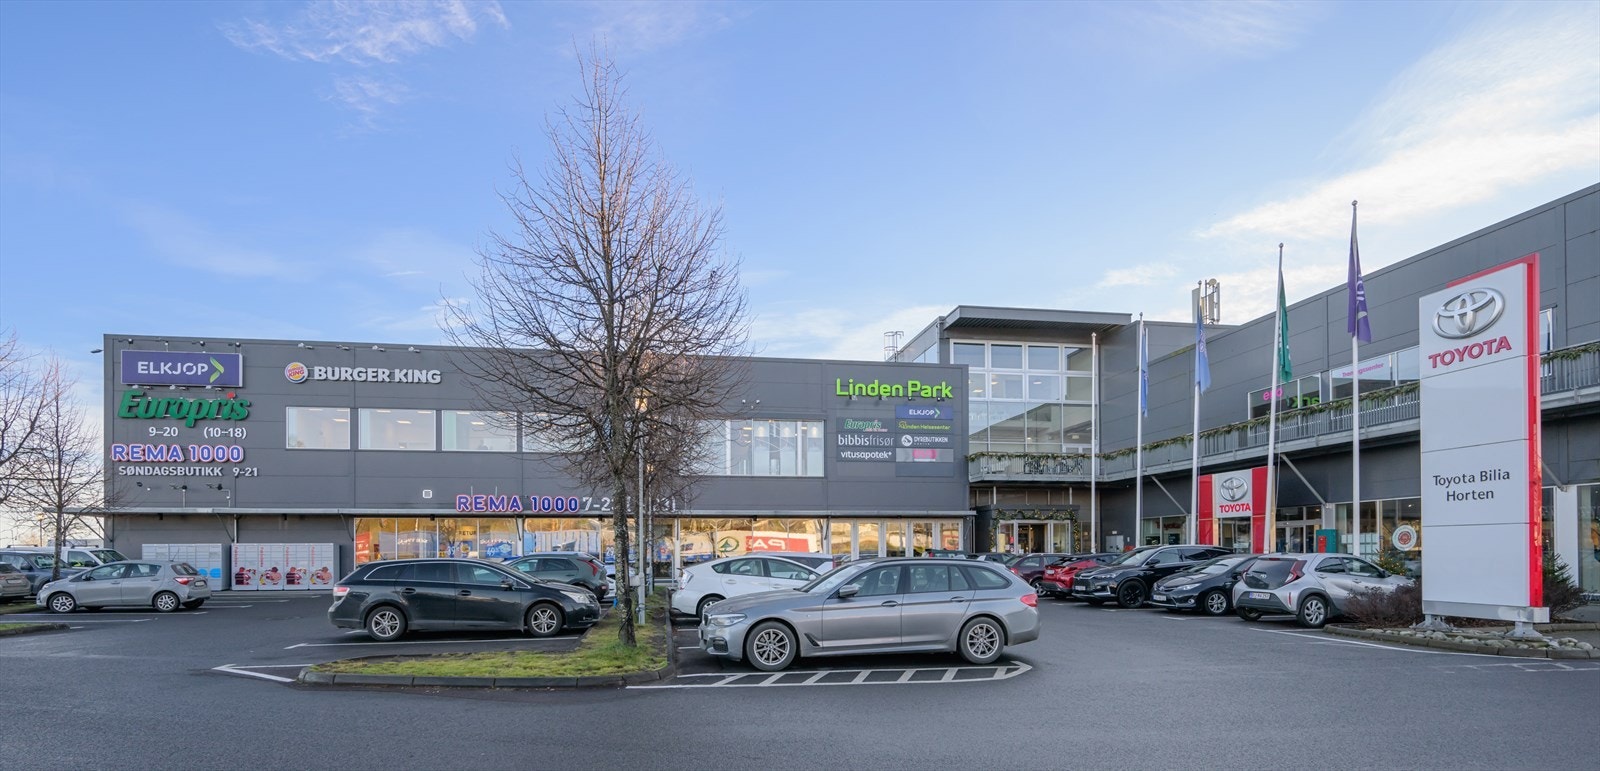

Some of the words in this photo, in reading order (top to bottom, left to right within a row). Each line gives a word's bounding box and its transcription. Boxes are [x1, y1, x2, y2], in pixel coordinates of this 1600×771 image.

[1428, 335, 1512, 369] TOYOTA
[314, 366, 390, 382] BURGER
[394, 368, 441, 384] KING
[1342, 362, 1384, 377] Trengssenter
[836, 377, 904, 397] Linden
[907, 380, 953, 398] Park
[1263, 388, 1283, 401] eo
[118, 389, 250, 428] Europris
[149, 426, 178, 437] 9-20
[203, 426, 247, 439] (10-18)
[837, 434, 895, 446] bibbisfrisør
[111, 443, 185, 462] REMA
[189, 444, 244, 462] 1000
[118, 465, 223, 476] SØNDAGSBUTIKK
[232, 467, 258, 477] 9-21
[1433, 473, 1475, 489] Toyota
[1479, 468, 1510, 482] Bilia
[1446, 488, 1494, 502] Horten
[455, 494, 523, 512] REMA
[531, 495, 580, 513] 1000
[1219, 502, 1252, 513] TOYOTA
